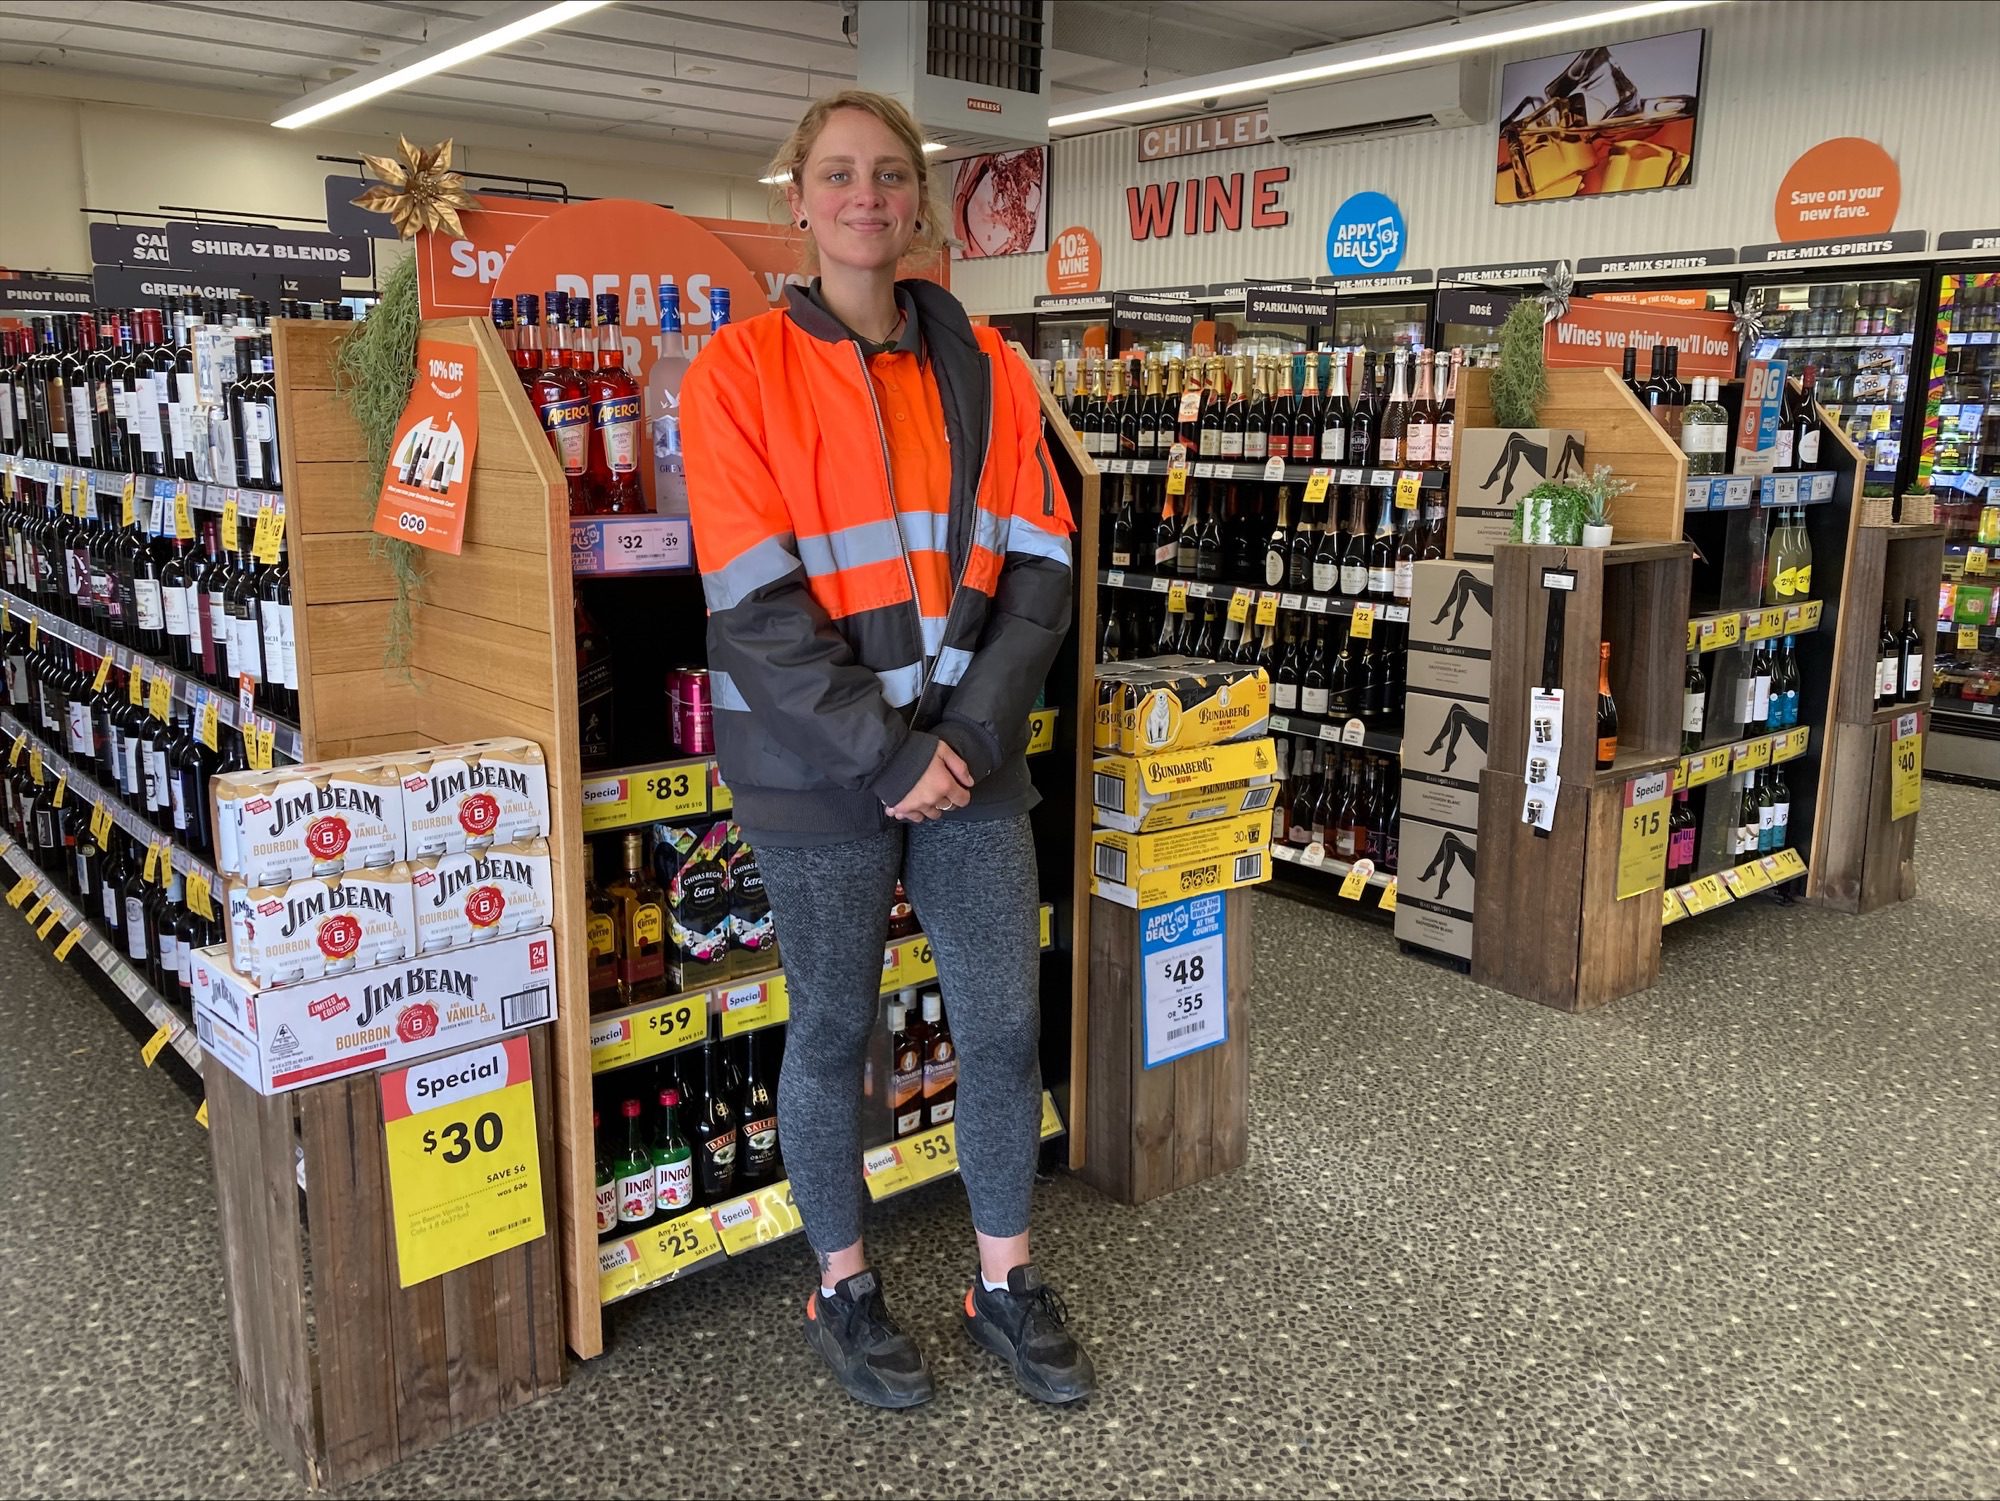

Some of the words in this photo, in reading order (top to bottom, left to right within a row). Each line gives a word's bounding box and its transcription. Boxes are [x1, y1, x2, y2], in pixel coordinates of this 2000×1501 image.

[968, 98, 1001, 112] PEERLESS
[1143, 113, 1269, 157] CHILLED
[1127, 167, 1290, 241] WINE
[1790, 191, 1825, 205] Save
[1827, 189, 1846, 201] on
[1847, 186, 1884, 202] your
[1800, 208, 1832, 221] new
[1833, 205, 1870, 219] fave.
[1337, 223, 1377, 241] APPY
[191, 239, 270, 258] SHIRAZ
[273, 244, 351, 263] BLENDS
[1058, 234, 1087, 257] 10%
[1077, 246, 1089, 256] OFF
[1333, 240, 1378, 258] DEALS
[1767, 246, 1829, 262] PRE-MIX
[1830, 240, 1893, 256] SPIRITS
[1058, 257, 1089, 275] WINE
[1458, 270, 1502, 281] PRE-MIX
[1503, 267, 1548, 279] SPIRITS
[1601, 260, 1654, 273] PRE-MIX
[1654, 257, 1707, 270] SPIRITS
[1334, 279, 1373, 289] PRE-MIX
[1374, 276, 1412, 287] SPIRITS
[6, 288, 51, 302] PINOT
[53, 290, 91, 304] NOIR
[555, 274, 712, 327] DEALS
[1067, 295, 1106, 306] SPARKLING
[1648, 296, 1660, 304] THE
[1117, 310, 1142, 321] PINOT
[1142, 312, 1192, 324] GRIS/GRIGIO
[1253, 301, 1303, 314] SPARKLING
[1303, 303, 1328, 316] WINE
[1469, 303, 1492, 316] ROSÉ
[1557, 323, 1602, 347] Wines
[1605, 331, 1626, 348] we
[1629, 330, 1662, 350] think
[1666, 335, 1700, 354] you'll
[1702, 336, 1728, 356] love
[429, 359, 448, 378] 10%
[449, 361, 464, 382] OFF
[1750, 368, 1781, 400] BIG
[548, 403, 591, 426] APEROL
[598, 402, 640, 424] APEROL
[617, 535, 643, 549] $32
[662, 537, 678, 547] $39
[1356, 612, 1369, 621] $22
[1258, 684, 1267, 692] 10
[1199, 704, 1250, 725] BUNDABERG
[1149, 758, 1213, 783] BUNDABERG
[1899, 751, 1915, 773] $40
[426, 771, 467, 814] JIM
[468, 762, 530, 798] BEAM
[584, 787, 620, 801] Special
[646, 774, 690, 800] $83
[1636, 781, 1664, 799] Special
[269, 793, 314, 838] JIM
[316, 784, 384, 821] BEAM
[503, 801, 533, 815] VANILLA
[354, 824, 389, 839] VANILLA
[412, 815, 453, 832] BOURBON
[1633, 811, 1660, 837] $15
[382, 833, 397, 842] COLA
[253, 839, 299, 857] BOURBON
[734, 863, 755, 875] CHIVAS
[433, 864, 473, 908] JIM
[475, 856, 534, 890] BEAM
[684, 873, 706, 886] CHIVAS
[706, 871, 723, 879] REGAL
[508, 892, 538, 906] VANILLA
[694, 887, 715, 898] Extra
[281, 892, 326, 938] JIM
[328, 883, 394, 918] BEAM
[420, 908, 460, 926] BOURBON
[365, 920, 399, 936] VANILLA
[1148, 912, 1175, 929] APPY
[1196, 918, 1204, 927] AT
[1205, 916, 1215, 925] THE
[1146, 924, 1177, 942] DEALS
[1193, 924, 1219, 936] COUNTER
[265, 938, 311, 958] BOURBON
[532, 945, 545, 959] 24
[1164, 955, 1205, 985] $48
[311, 996, 337, 1014] LIMITED
[357, 976, 408, 1028] JIM
[406, 967, 475, 1001] BEAM
[730, 990, 761, 1006] Special
[1168, 1011, 1177, 1019] OR
[1178, 993, 1203, 1013] $55
[322, 1001, 347, 1019] EDITION
[447, 1003, 487, 1024] VANILLA
[480, 1013, 496, 1024] COLA
[649, 1007, 691, 1036] $59
[336, 1025, 391, 1051] BOURBON
[590, 1028, 622, 1047] Special
[416, 1056, 500, 1099] Special
[422, 1112, 504, 1165] $30
[914, 1135, 951, 1160] $53
[868, 1154, 896, 1171] Special
[486, 1167, 512, 1184] SAVE
[514, 1163, 526, 1175] $6
[660, 1164, 691, 1183] JINRO
[497, 1188, 512, 1198] was
[722, 1206, 752, 1223] Special
[658, 1228, 672, 1237] Any
[671, 1223, 678, 1232] 2
[679, 1220, 689, 1228] for
[659, 1228, 699, 1258] $25
[599, 1253, 615, 1265] Mix
[616, 1249, 625, 1258] or
[602, 1258, 628, 1272] Match
